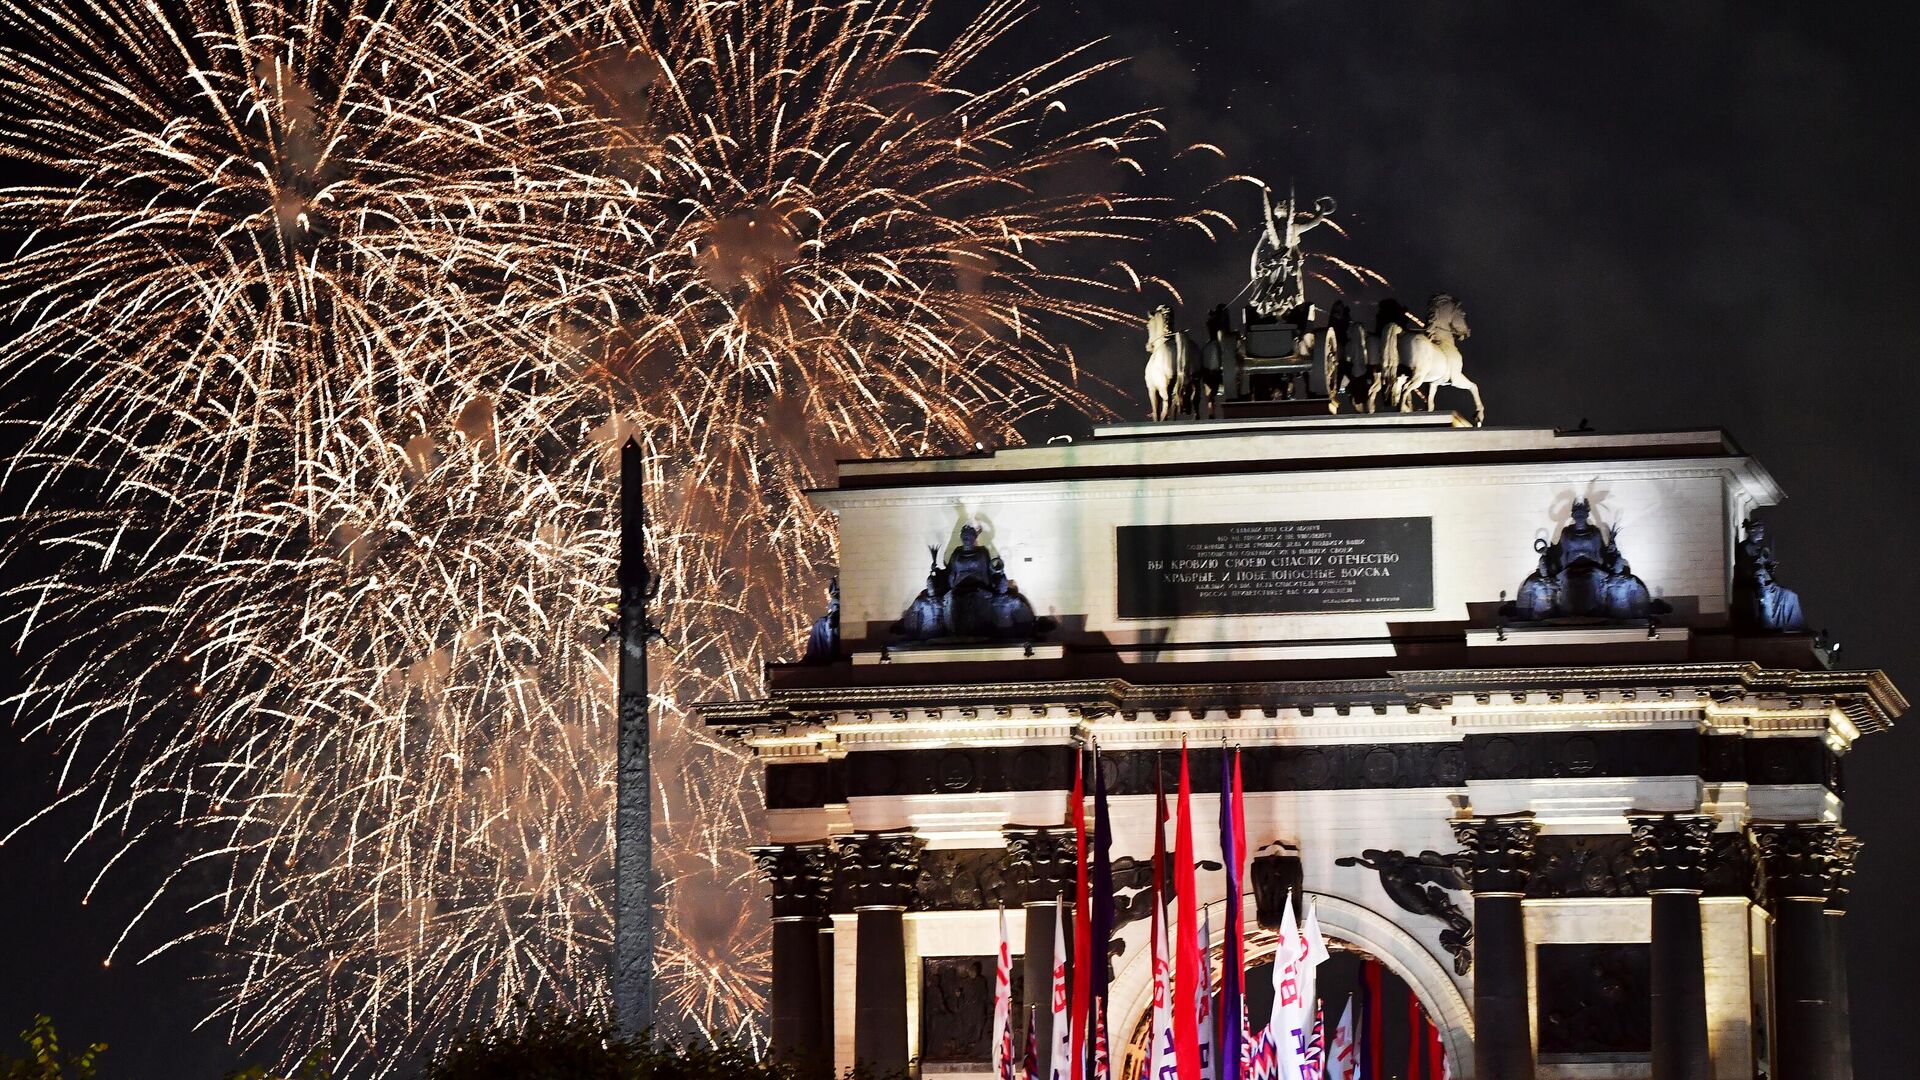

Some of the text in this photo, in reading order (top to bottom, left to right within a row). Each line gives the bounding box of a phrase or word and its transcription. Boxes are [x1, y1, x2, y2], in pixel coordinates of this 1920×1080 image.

[1148, 553, 1400, 570] ВЫ КРОВИЮ СВОЕЮ СПАСЛИ ОТЕЧЕСТВО
[1164, 572, 1216, 583] ХРАБРЫЕ
[1222, 572, 1230, 582] И
[1341, 567, 1390, 578] ВОЙСКА
